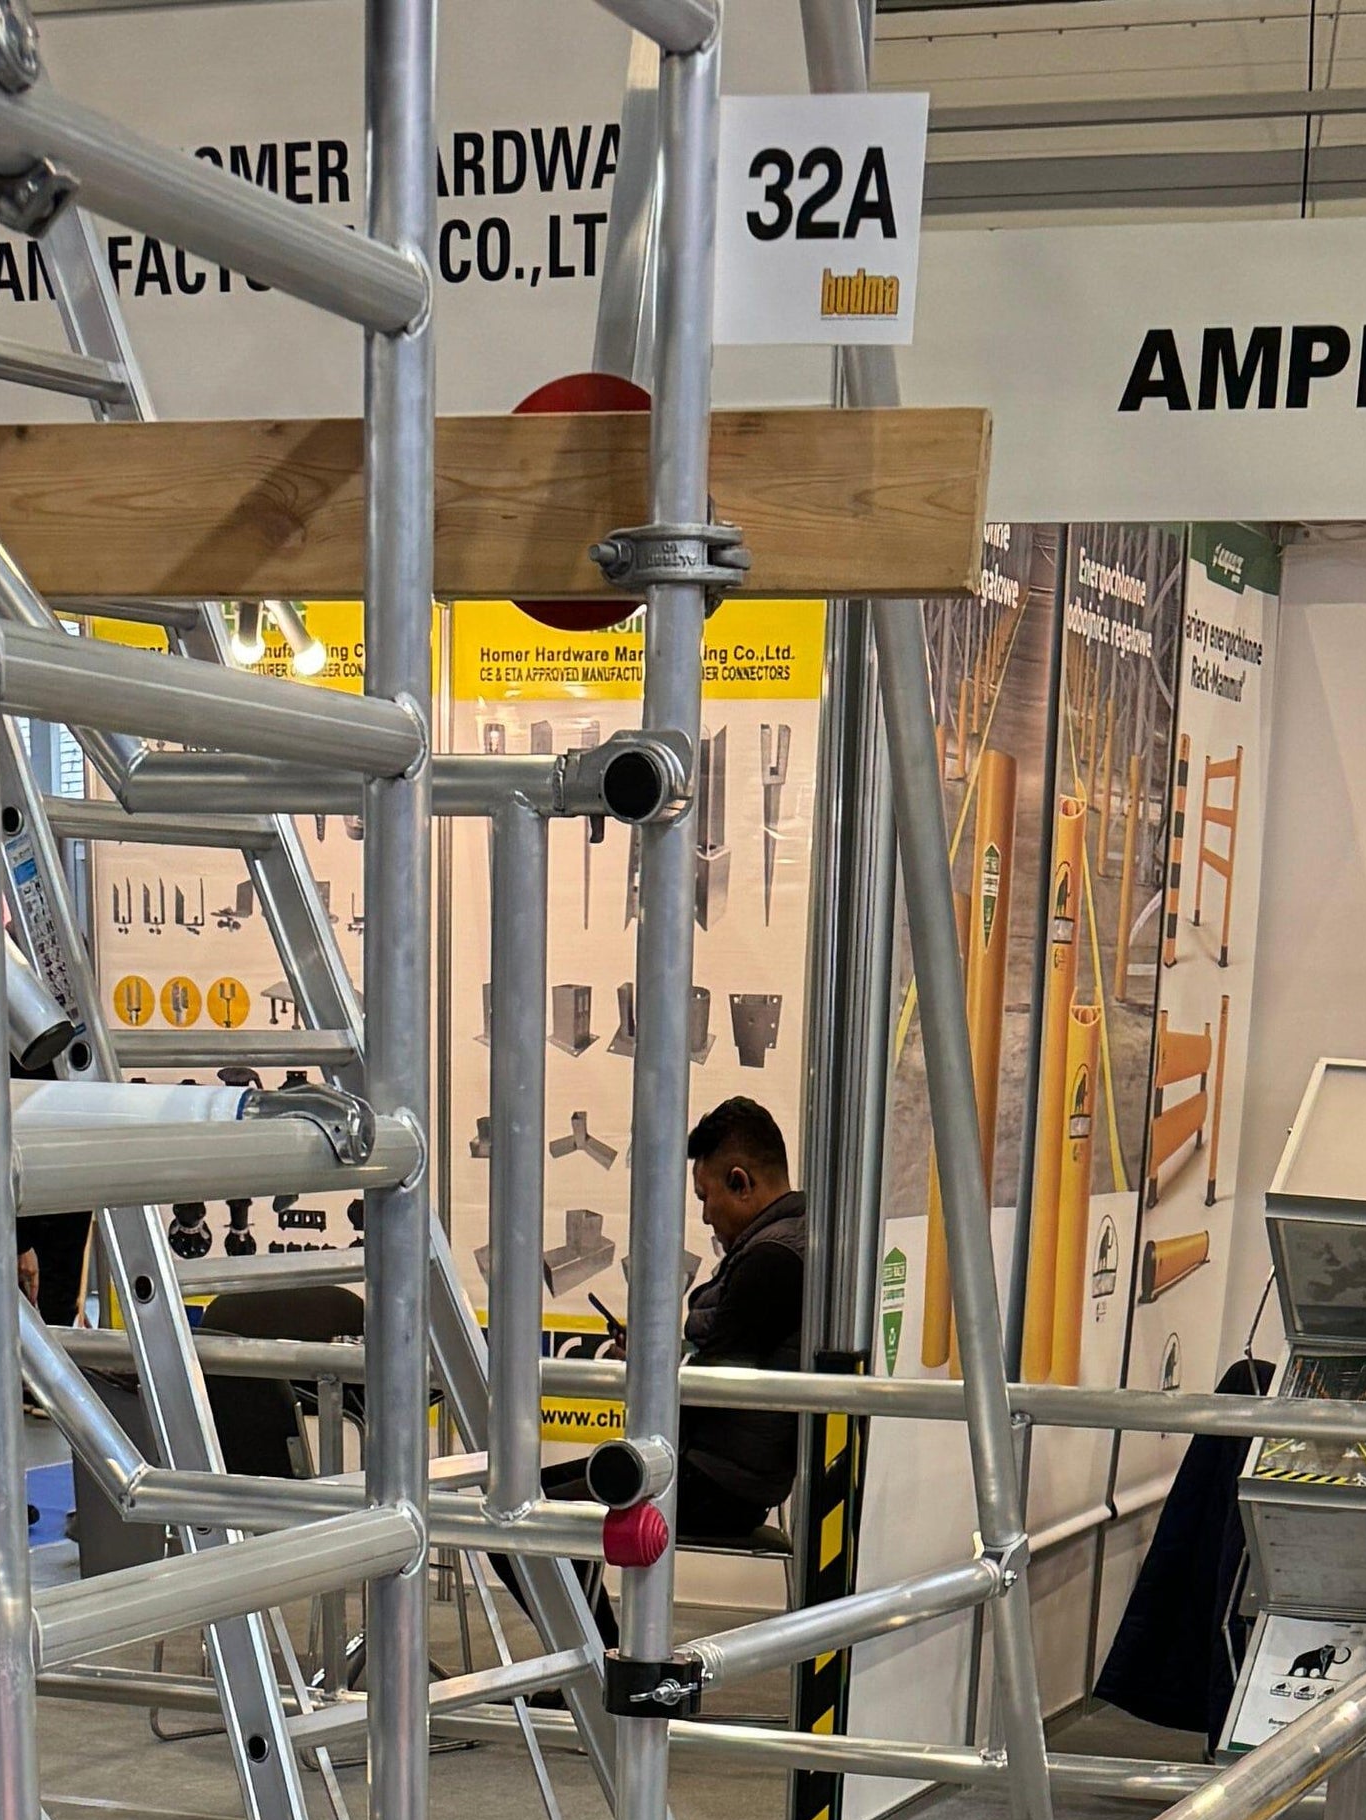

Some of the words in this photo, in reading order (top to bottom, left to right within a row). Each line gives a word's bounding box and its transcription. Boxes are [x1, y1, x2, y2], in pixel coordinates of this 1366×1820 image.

[746, 146, 898, 241] 32A
[820, 267, 900, 316] budma
[480, 647, 530, 662] Homer
[535, 647, 609, 662] Hardware
[480, 667, 494, 681] CE
